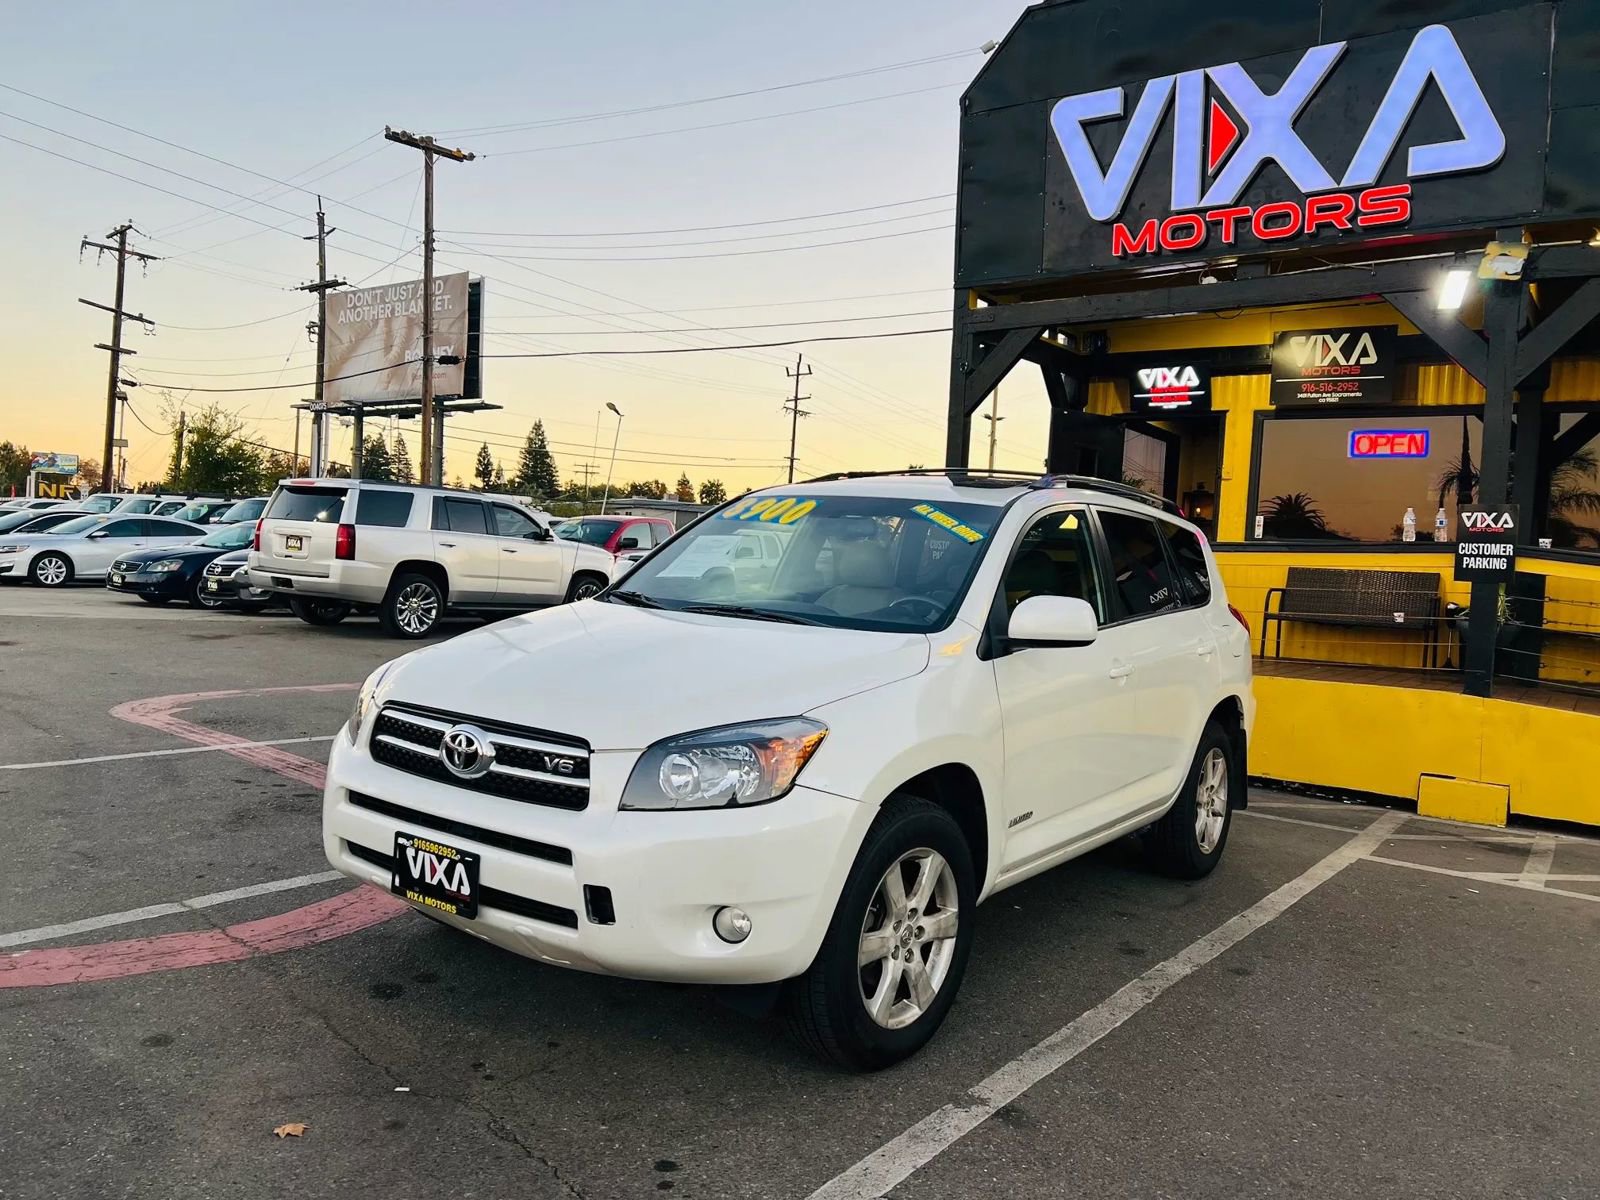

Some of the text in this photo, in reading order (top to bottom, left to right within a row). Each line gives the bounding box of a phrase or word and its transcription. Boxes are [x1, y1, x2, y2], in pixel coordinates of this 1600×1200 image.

[1050, 24, 1506, 222] VIXA
[1111, 184, 1412, 258] MOTORS
[347, 279, 444, 308] DON'T JUST AD
[338, 294, 453, 324] ANOTHER BLANET.
[1289, 332, 1378, 367] VIXA
[1138, 365, 1200, 389] VIXA
[1301, 366, 1361, 376] MOTORS
[1301, 382, 1359, 392] 916-516-2952
[1356, 433, 1425, 454] OPEN
[1461, 512, 1515, 529] VIXA
[1458, 543, 1514, 556] CUSTOMER
[1462, 557, 1507, 570] PARKING
[544, 756, 574, 774] V6
[406, 847, 471, 896] VIXA
[406, 890, 457, 914] VIXA MOTORS
